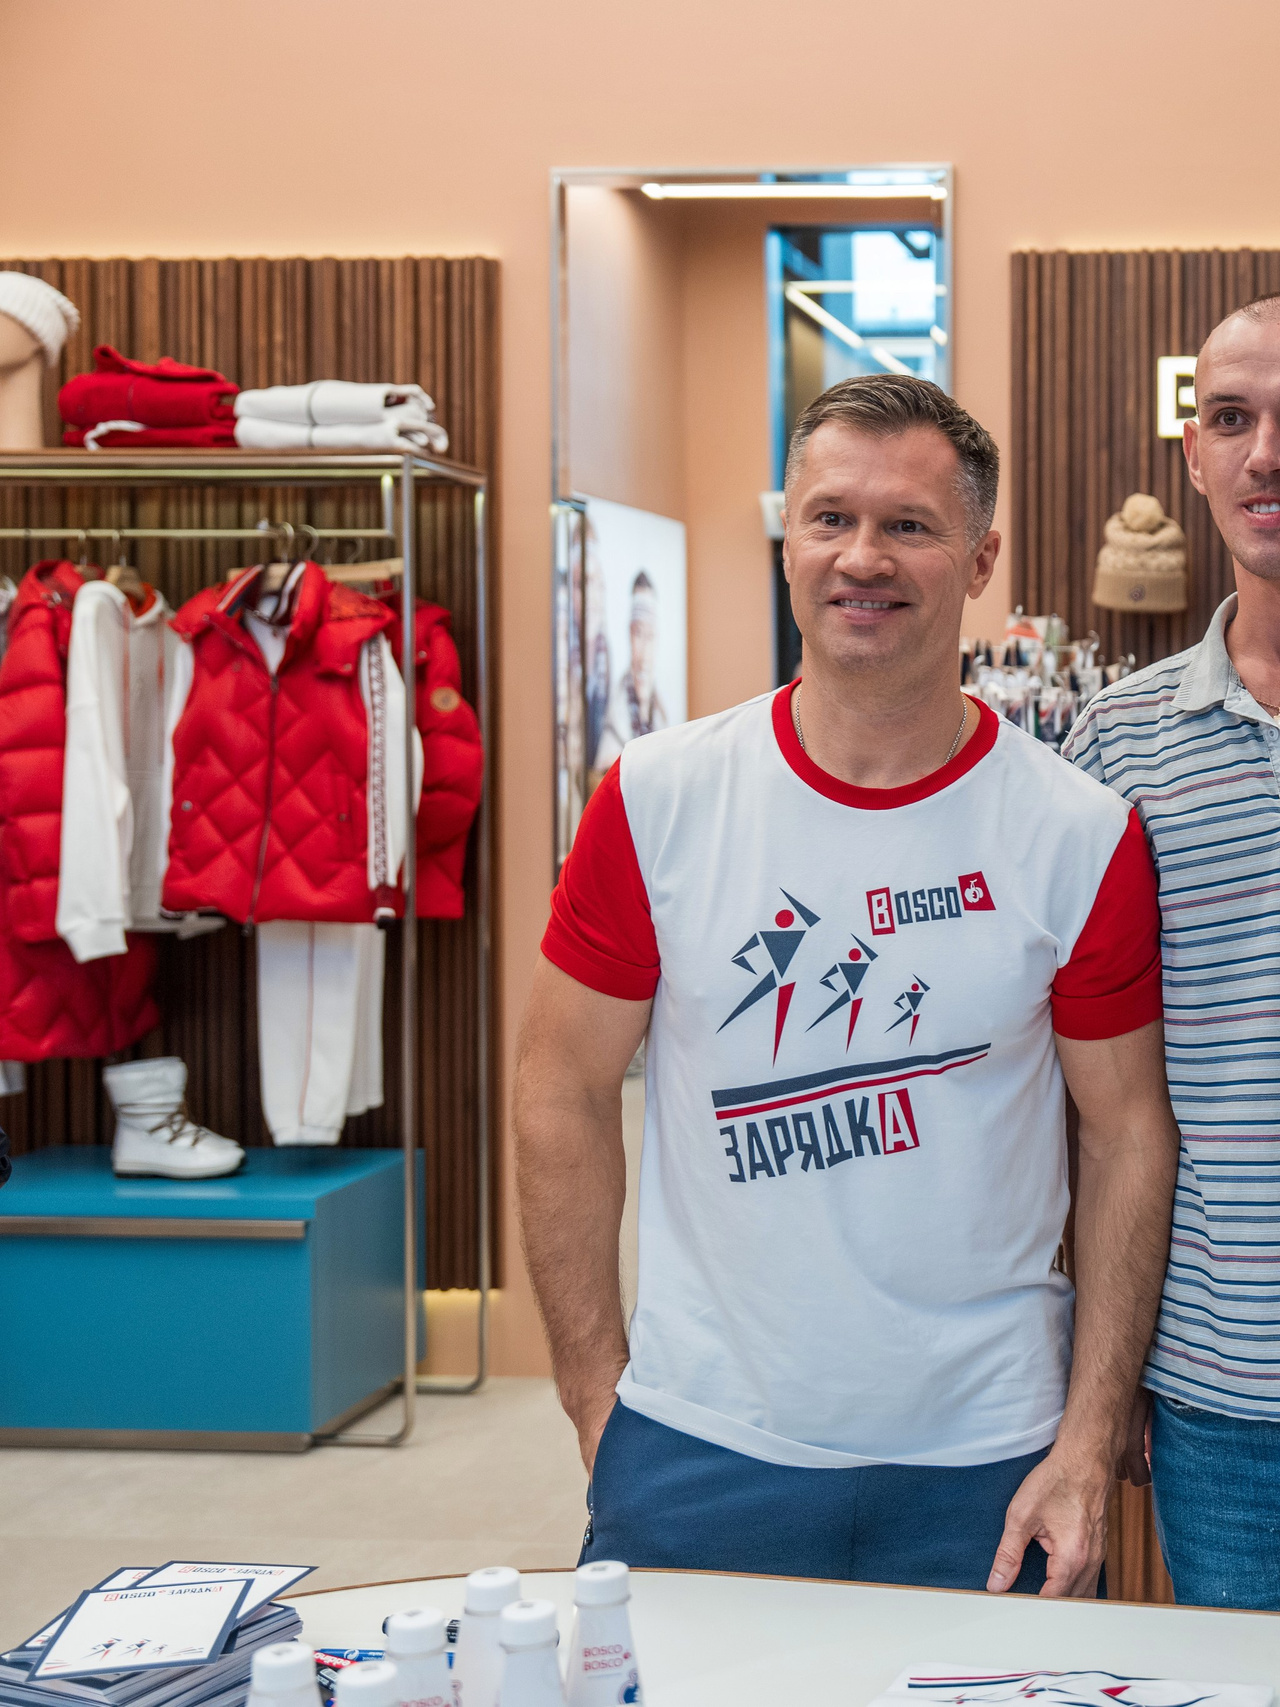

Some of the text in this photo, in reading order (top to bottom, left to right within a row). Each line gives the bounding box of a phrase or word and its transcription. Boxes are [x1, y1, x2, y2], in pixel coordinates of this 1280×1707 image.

[866, 886, 962, 935] BOSCO
[719, 1088, 919, 1182] ЗАРЯДКА
[583, 1644, 622, 1657] BOSCO
[583, 1658, 622, 1670] BOSCO
